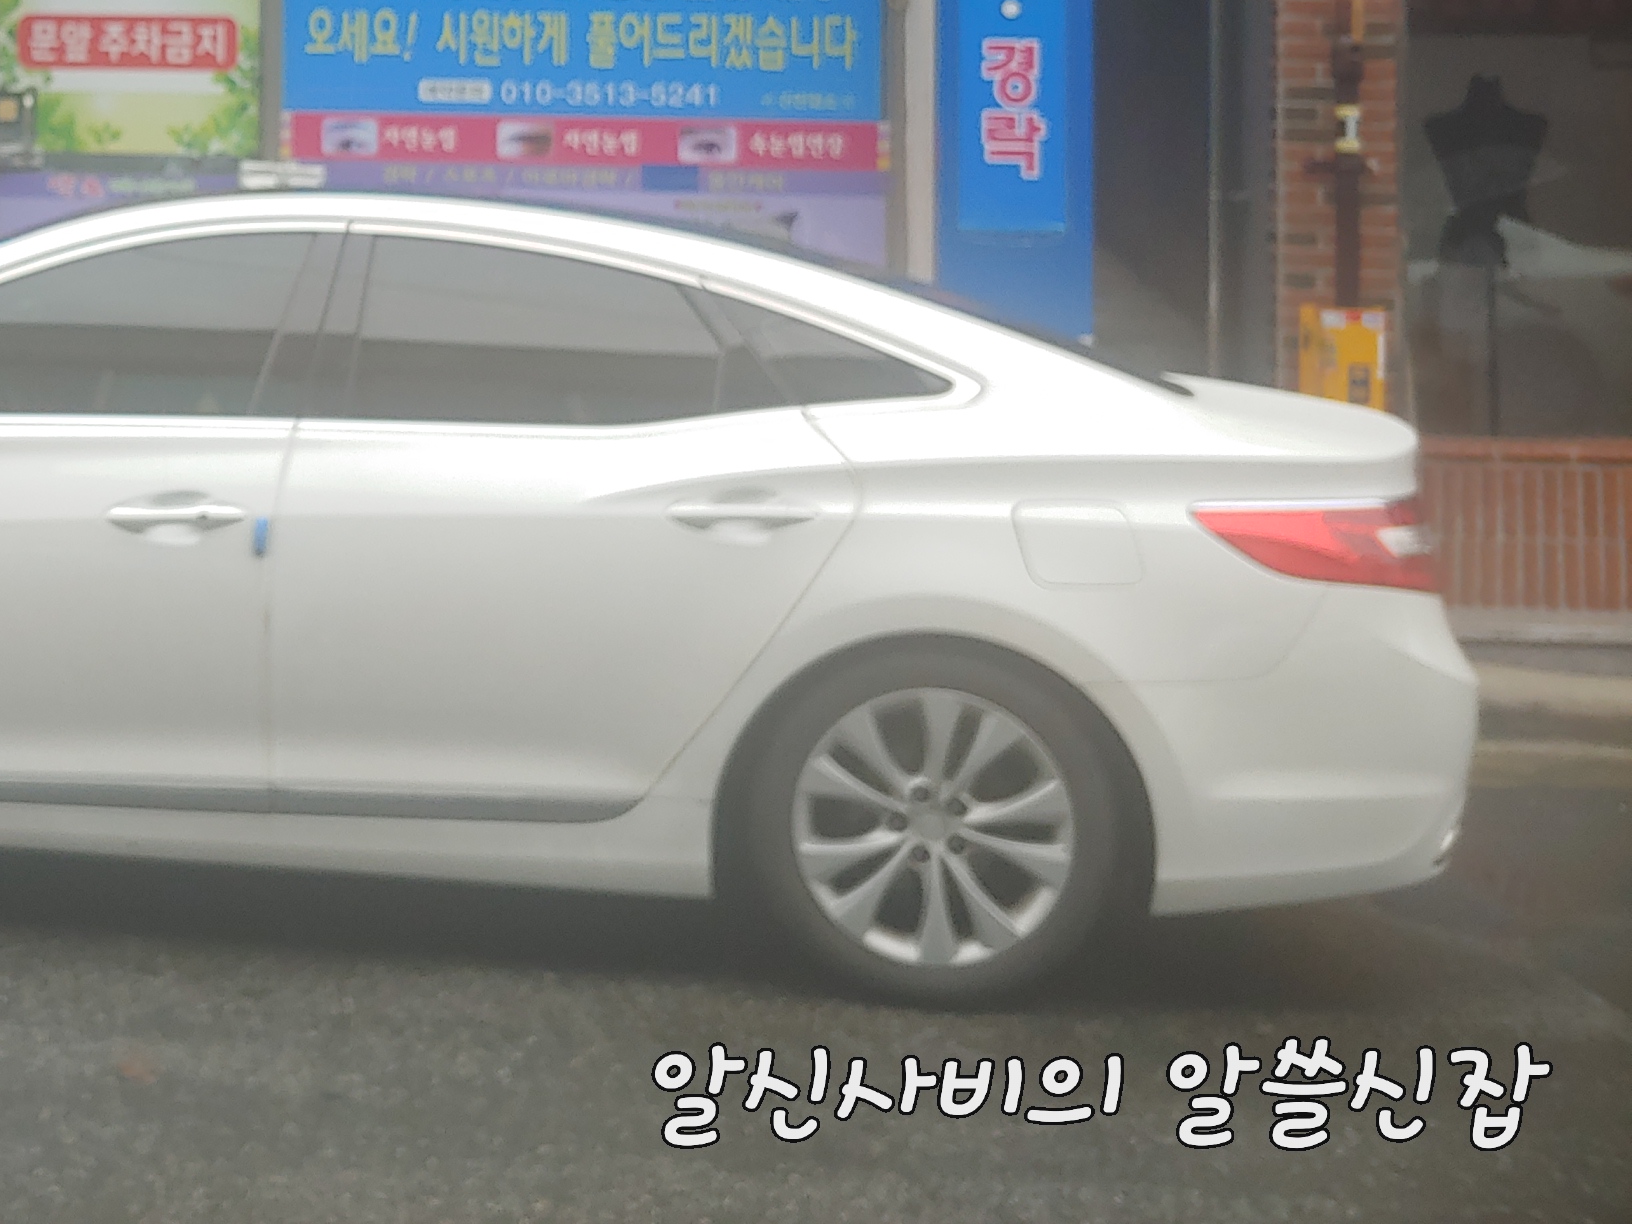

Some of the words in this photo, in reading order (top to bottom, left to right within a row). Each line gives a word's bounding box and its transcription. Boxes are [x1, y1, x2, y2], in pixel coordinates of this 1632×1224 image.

[98, 20, 228, 66] 주차금지
[303, 6, 418, 63] 오세요!
[436, 8, 568, 67] 시원하게
[586, 9, 858, 71] 풀어드리겠습니다
[500, 79, 719, 108] 010-3513-5241
